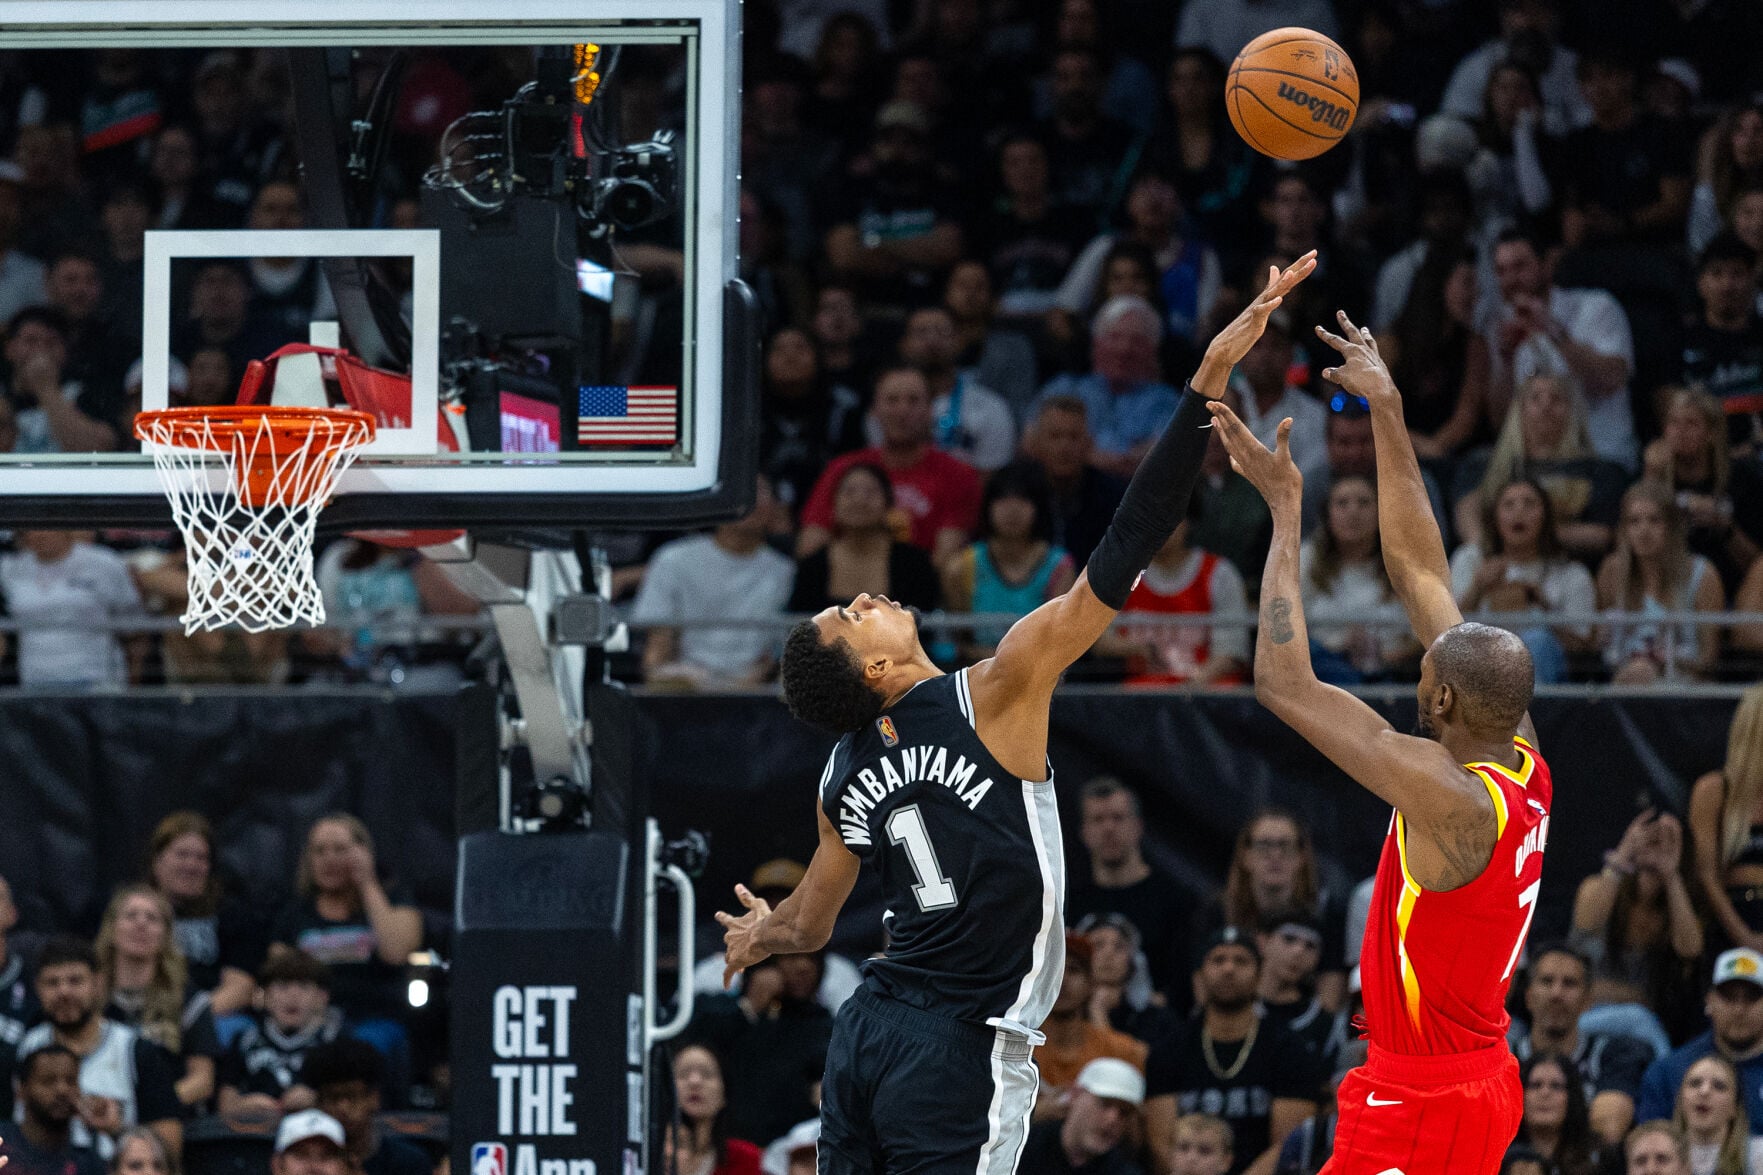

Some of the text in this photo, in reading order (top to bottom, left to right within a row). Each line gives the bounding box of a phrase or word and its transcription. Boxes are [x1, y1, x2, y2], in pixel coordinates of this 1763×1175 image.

[1277, 82, 1350, 131] Wilson
[840, 745, 993, 845] WEMBANYAMA
[885, 803, 958, 912] 1
[1500, 878, 1541, 983] 7
[493, 984, 577, 1059] GET
[491, 1064, 577, 1136] THE
